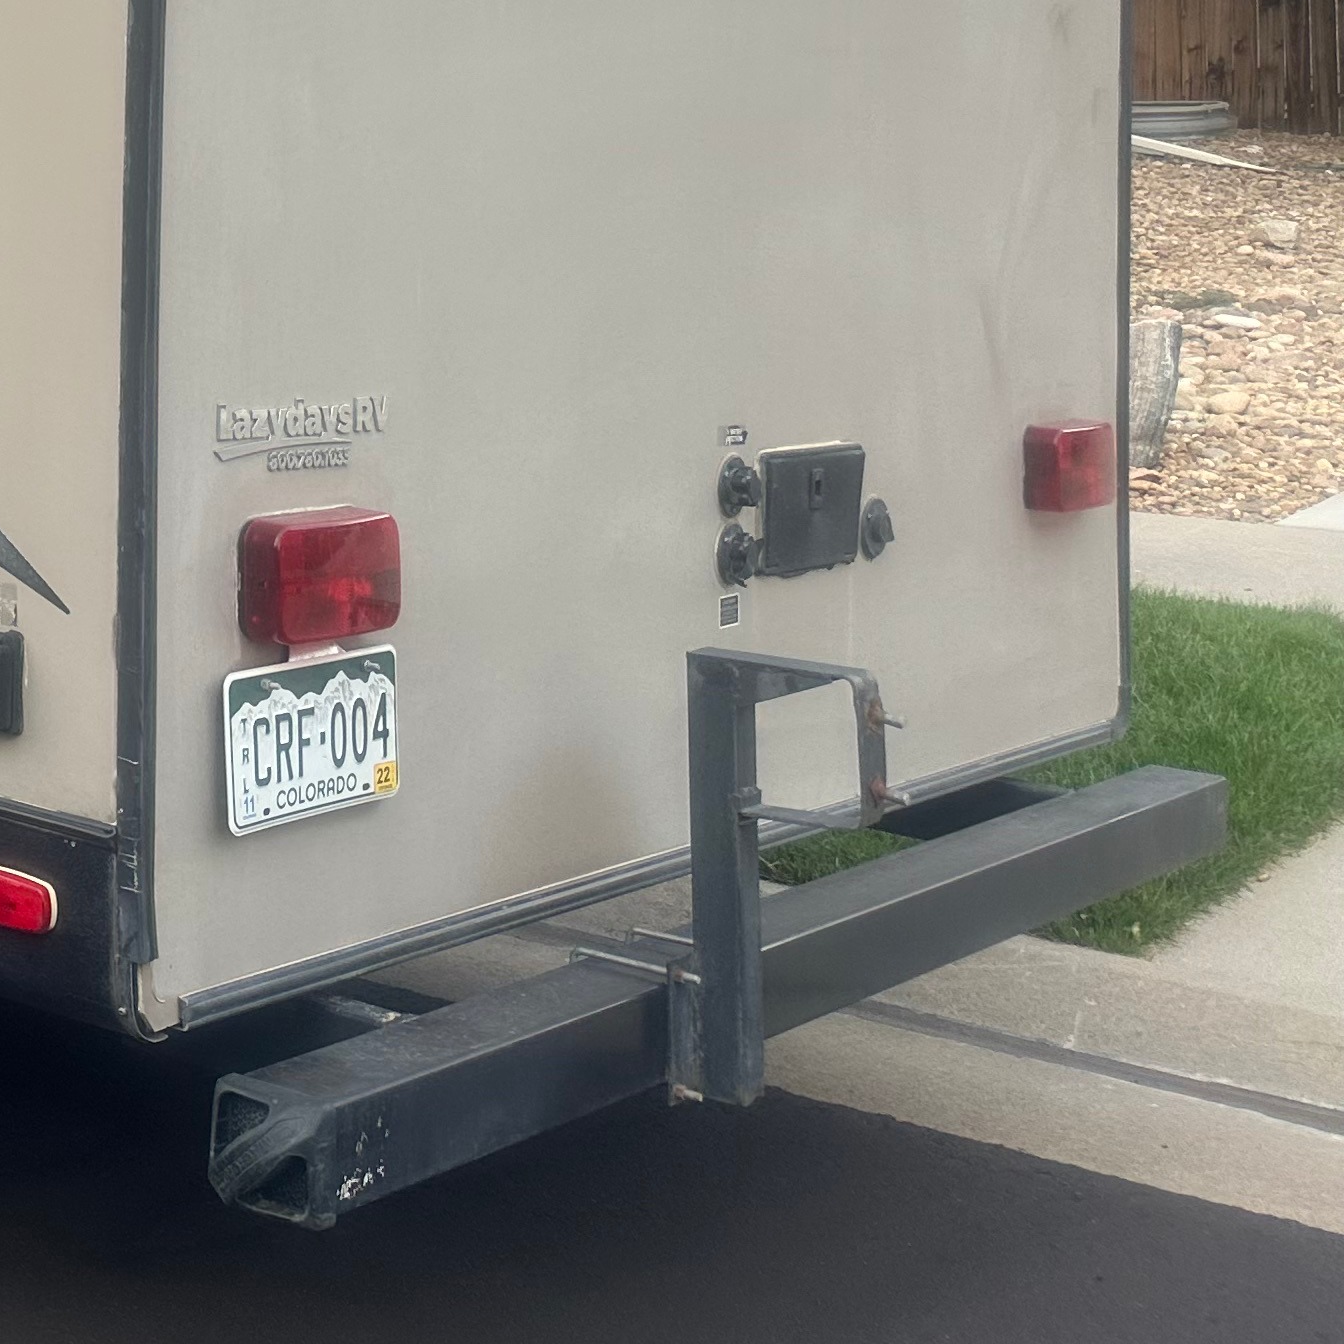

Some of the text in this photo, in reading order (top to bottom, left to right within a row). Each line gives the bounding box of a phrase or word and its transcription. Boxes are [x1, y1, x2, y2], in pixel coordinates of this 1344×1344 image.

[376, 766, 391, 785] 22
[276, 772, 358, 810] COLORADO
[243, 794, 256, 814] 11
